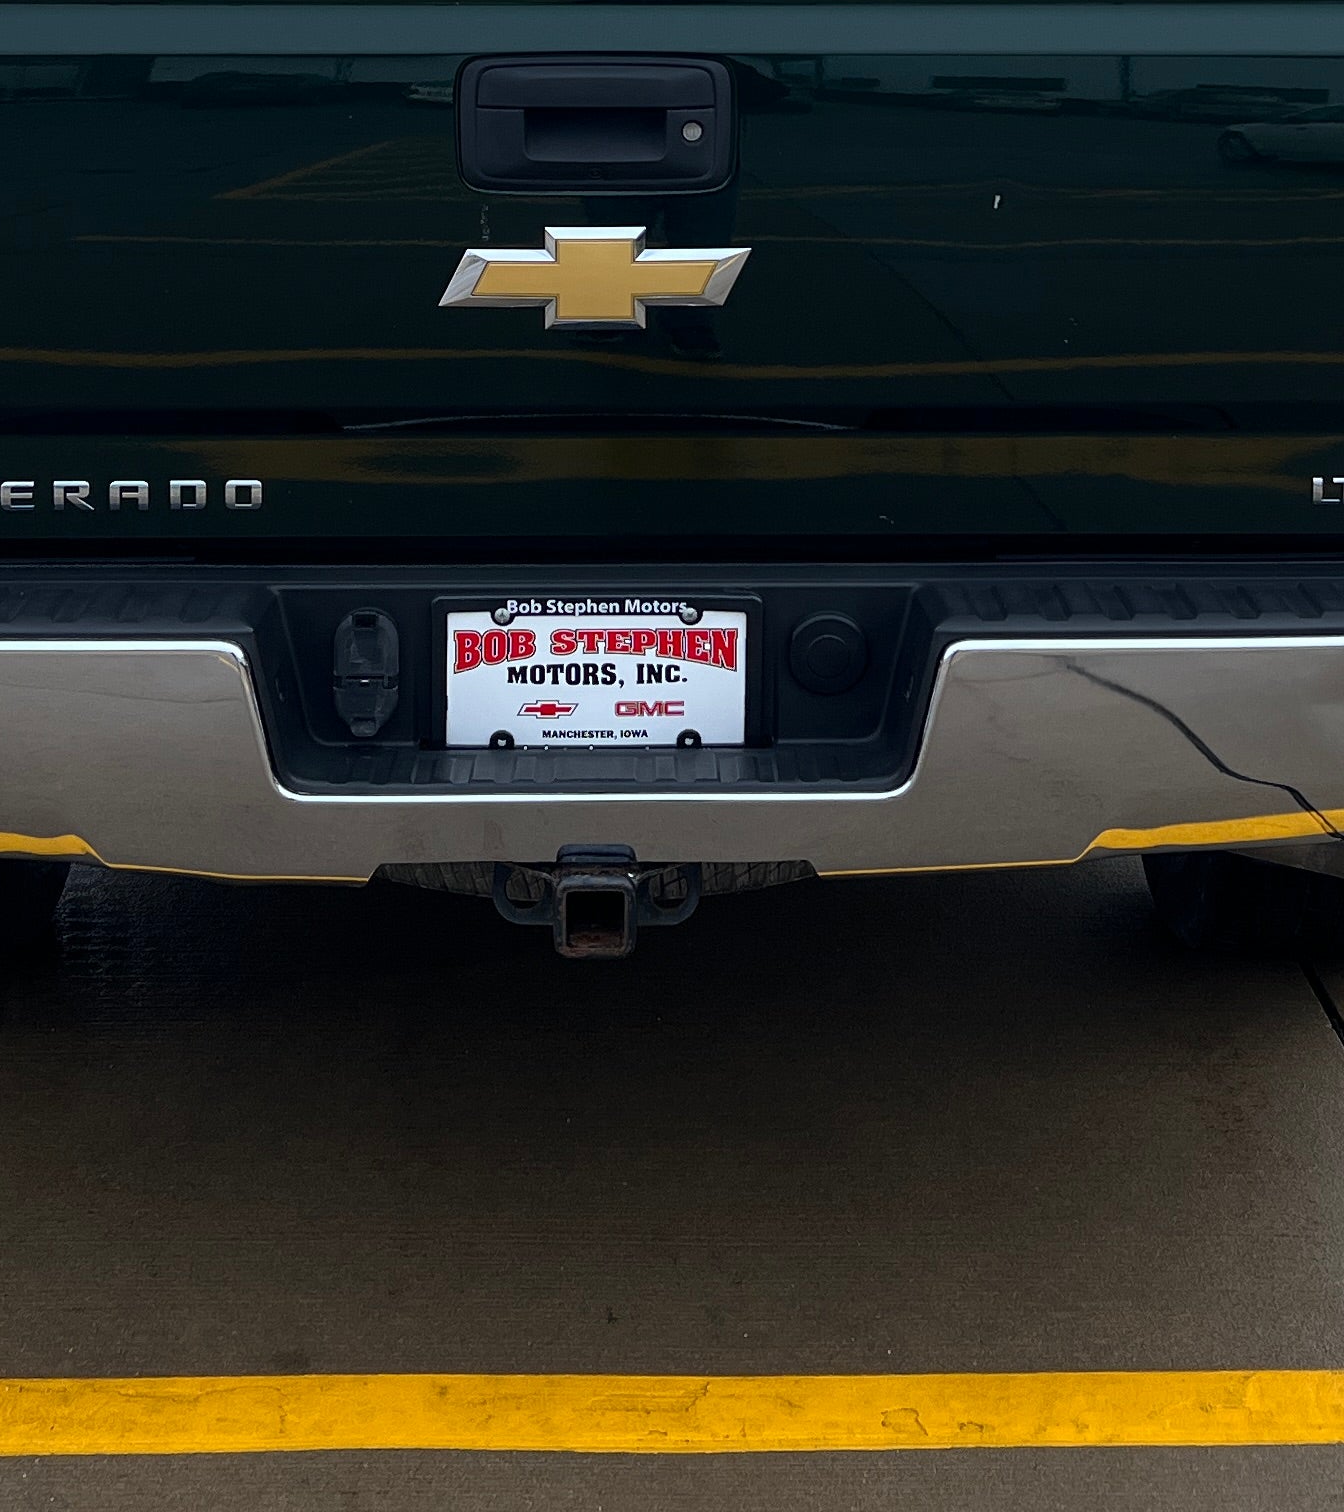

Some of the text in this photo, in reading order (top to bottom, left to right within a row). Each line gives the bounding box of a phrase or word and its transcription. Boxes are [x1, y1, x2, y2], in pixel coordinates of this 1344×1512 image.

[506, 599, 688, 617] Bob Stephen Motors
[454, 628, 739, 674] BOB STEPHEN
[507, 662, 688, 688] MOTORS, INC.
[614, 700, 685, 717] GMC
[542, 729, 649, 740] MANCHESTER, IOWA
